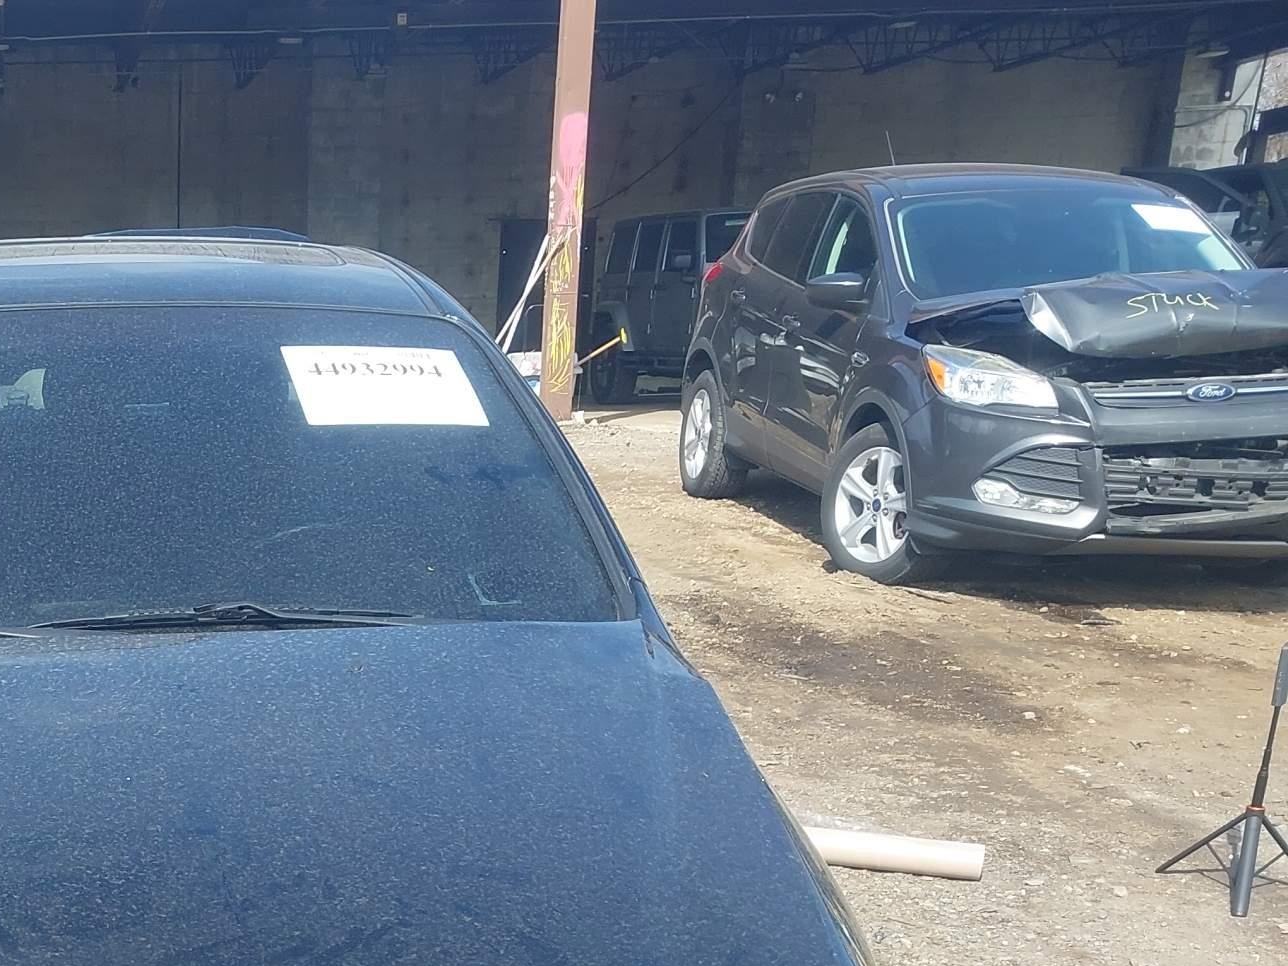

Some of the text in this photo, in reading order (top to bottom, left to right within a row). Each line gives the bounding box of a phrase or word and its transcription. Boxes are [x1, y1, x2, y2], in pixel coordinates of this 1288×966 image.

[1126, 292, 1219, 318] STUCK
[308, 362, 443, 378] 44932994
[1199, 385, 1226, 398] Ford
